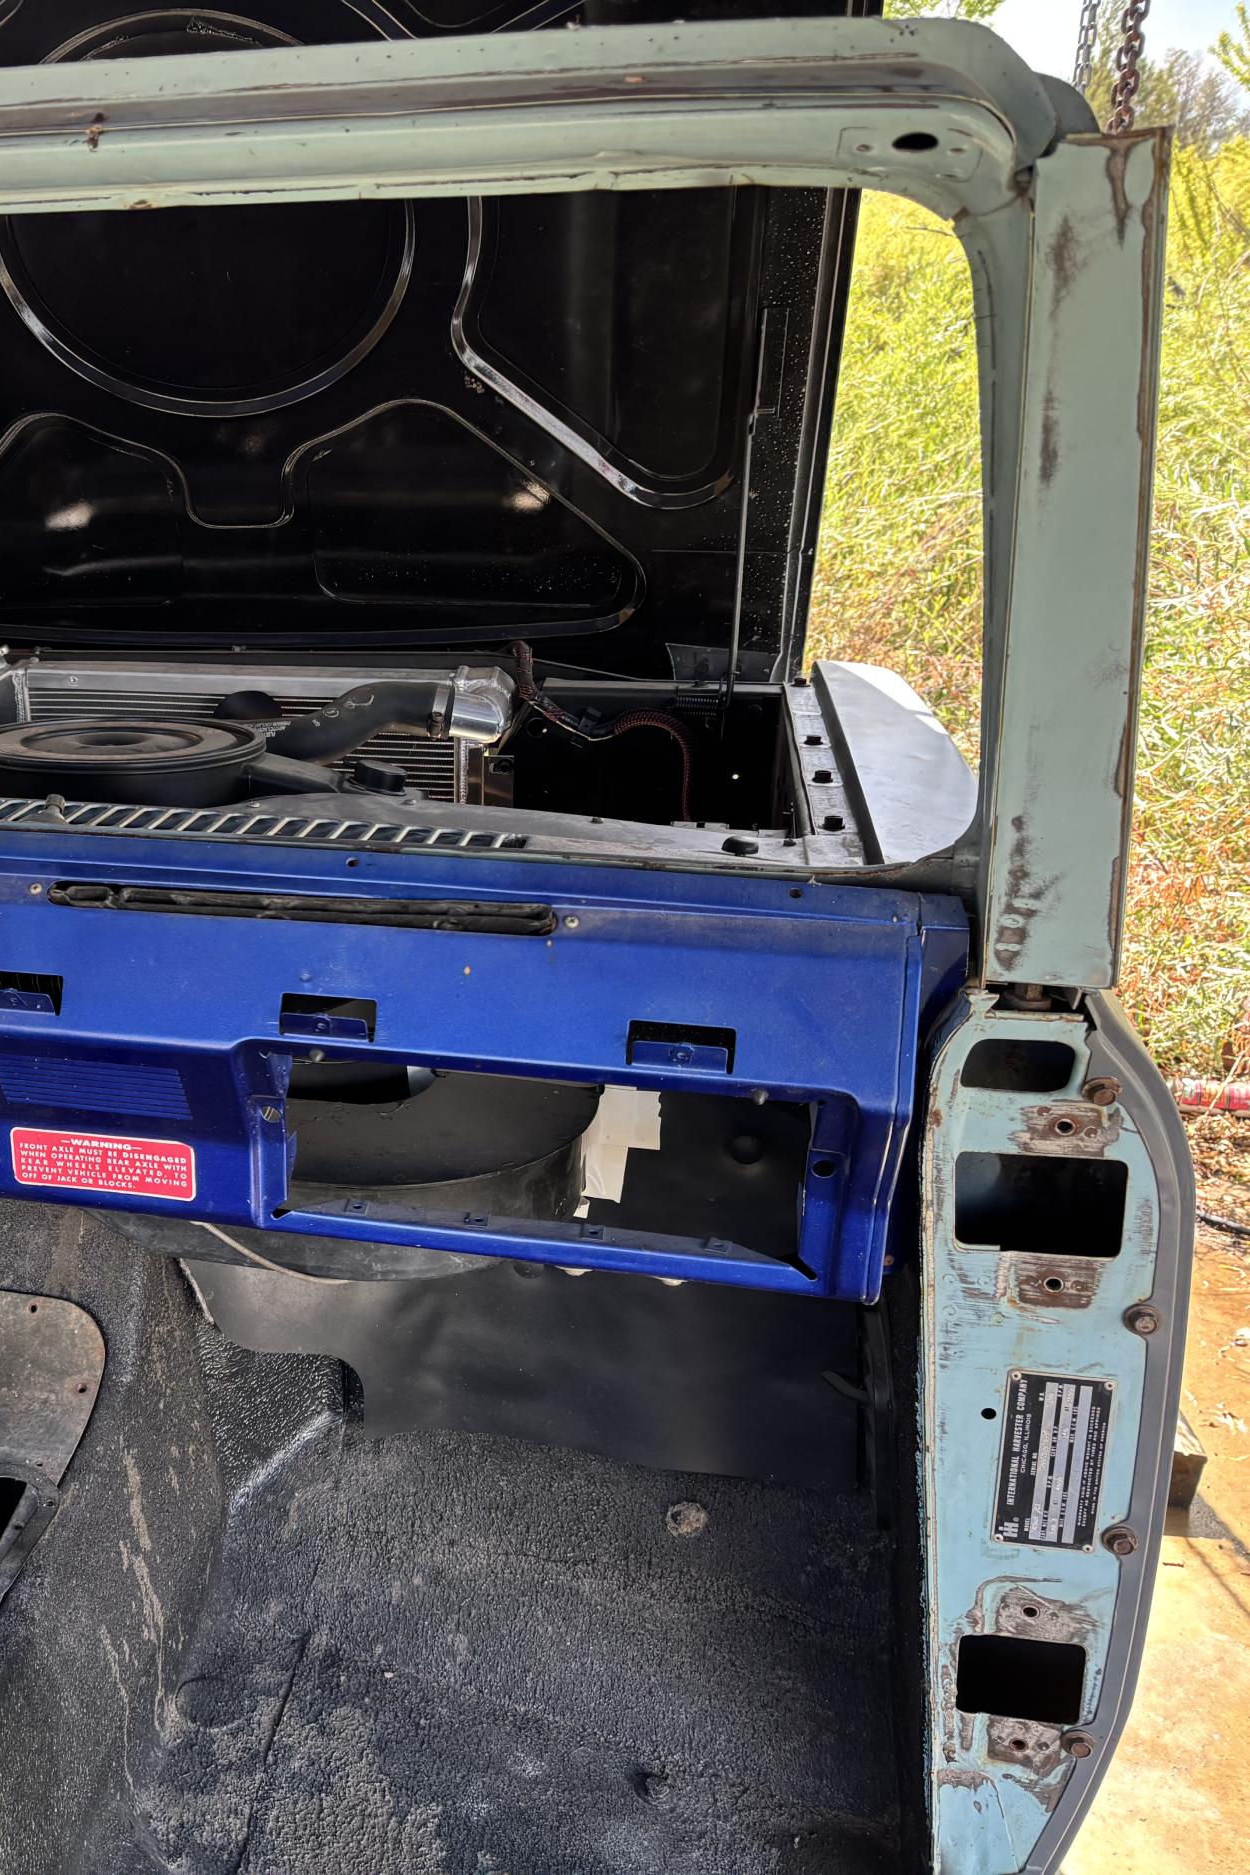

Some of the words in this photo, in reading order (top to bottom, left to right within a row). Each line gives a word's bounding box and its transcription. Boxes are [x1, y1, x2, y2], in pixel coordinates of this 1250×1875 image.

[19, 1142, 47, 1150] FRONT
[52, 1145, 73, 1153] AXLE
[78, 1147, 102, 1156] MUST
[122, 1152, 186, 1164] DISENGAGED
[20, 1149, 46, 1157] WHEN
[50, 1152, 101, 1163] OPERATING
[107, 1158, 129, 1166] REAR
[20, 1157, 48, 1165] REAR
[56, 1160, 100, 1170] WHEELS
[108, 1166, 166, 1177] ELEVATED,
[21, 1164, 62, 1174] PREVENT
[68, 1169, 106, 1178] VEHICLE
[112, 1173, 139, 1182] FROM
[145, 1177, 187, 1187] MOVING
[57, 1175, 77, 1183] JACK
[98, 1179, 135, 1189] BLOCKS.
[1016, 1378, 1028, 1410] COMPANY
[1011, 1414, 1024, 1451] HARVESTER
[1023, 1413, 1032, 1440] ILLINOIS
[1020, 1442, 1029, 1473] CHICAGO,
[1006, 1455, 1019, 1505] INTERNATIONAL
